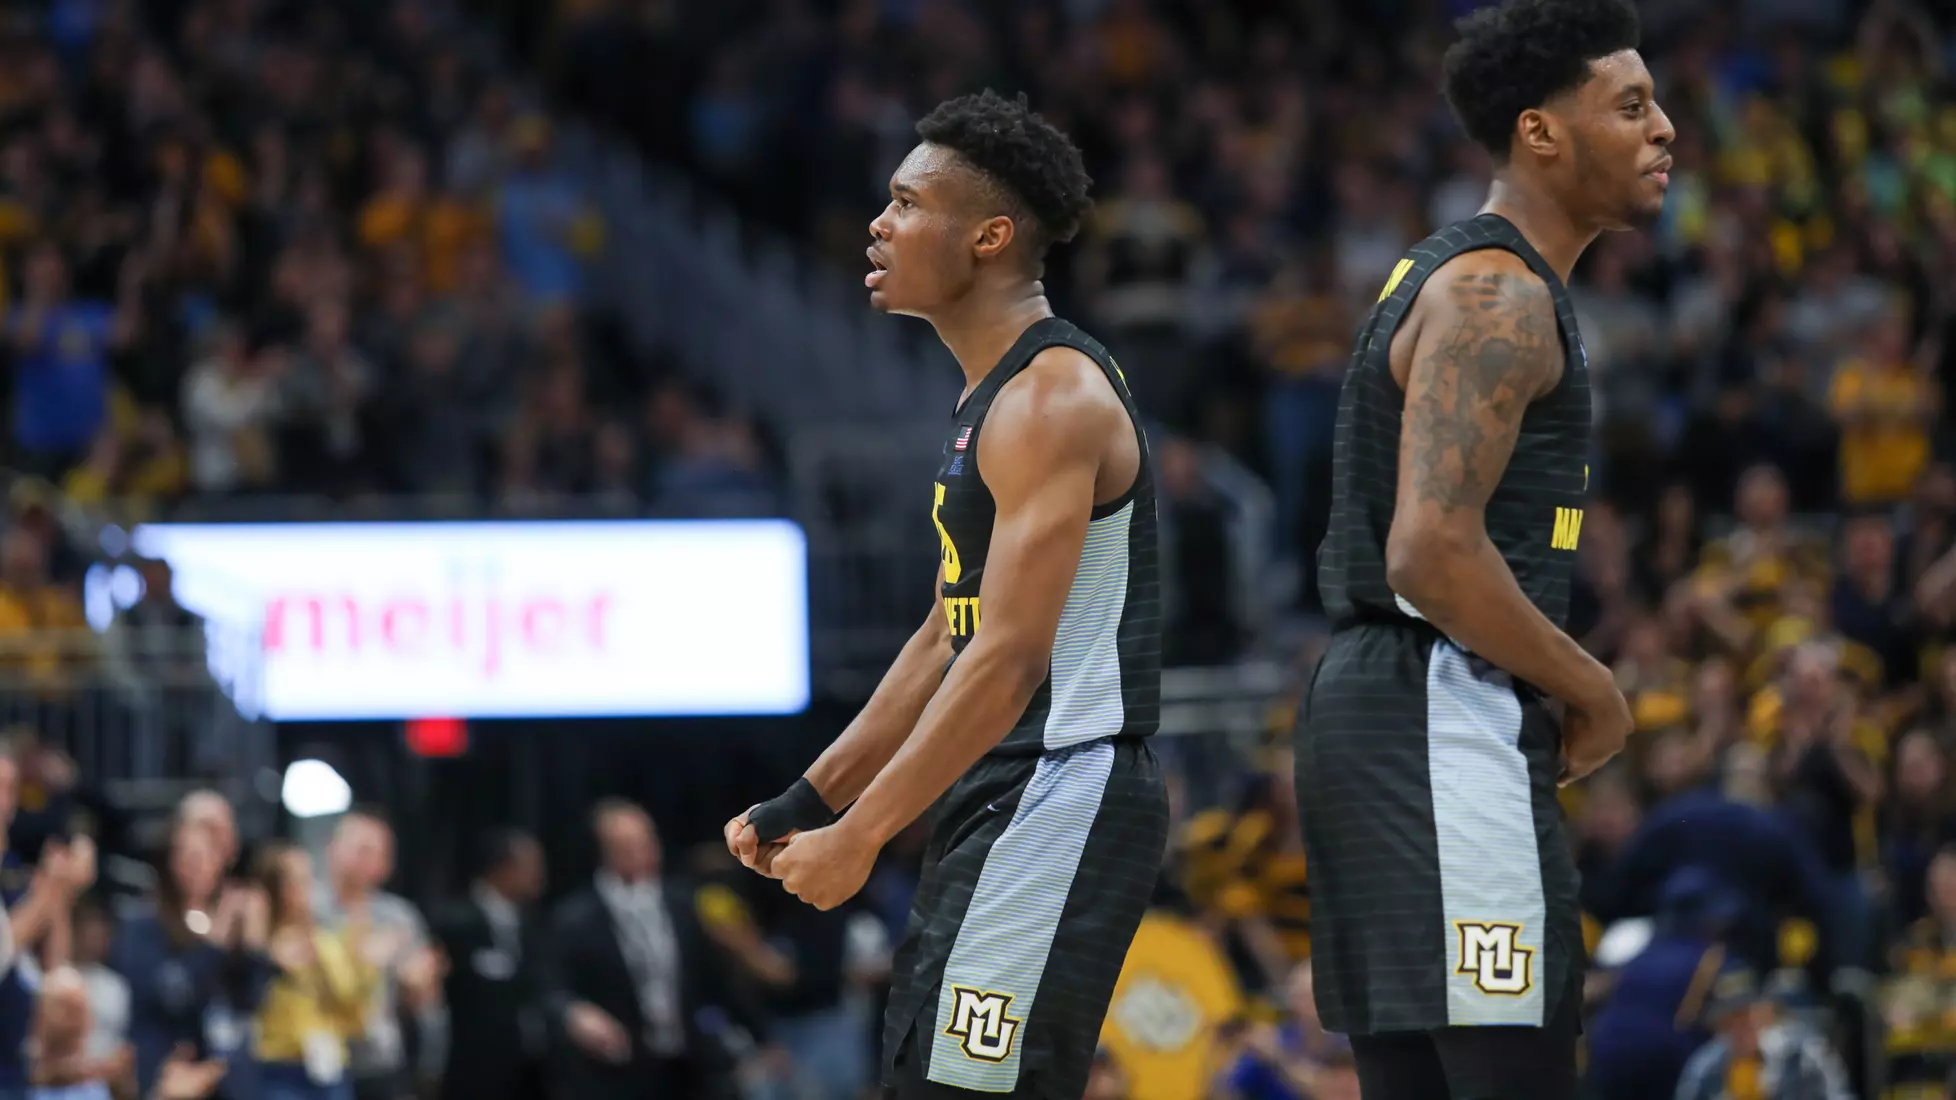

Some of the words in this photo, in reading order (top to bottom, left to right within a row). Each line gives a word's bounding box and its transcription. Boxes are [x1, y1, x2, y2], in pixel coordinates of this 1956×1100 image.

[261, 556, 613, 679] meijer
[1453, 920, 1536, 997] MU
[945, 985, 1022, 1064] MU
